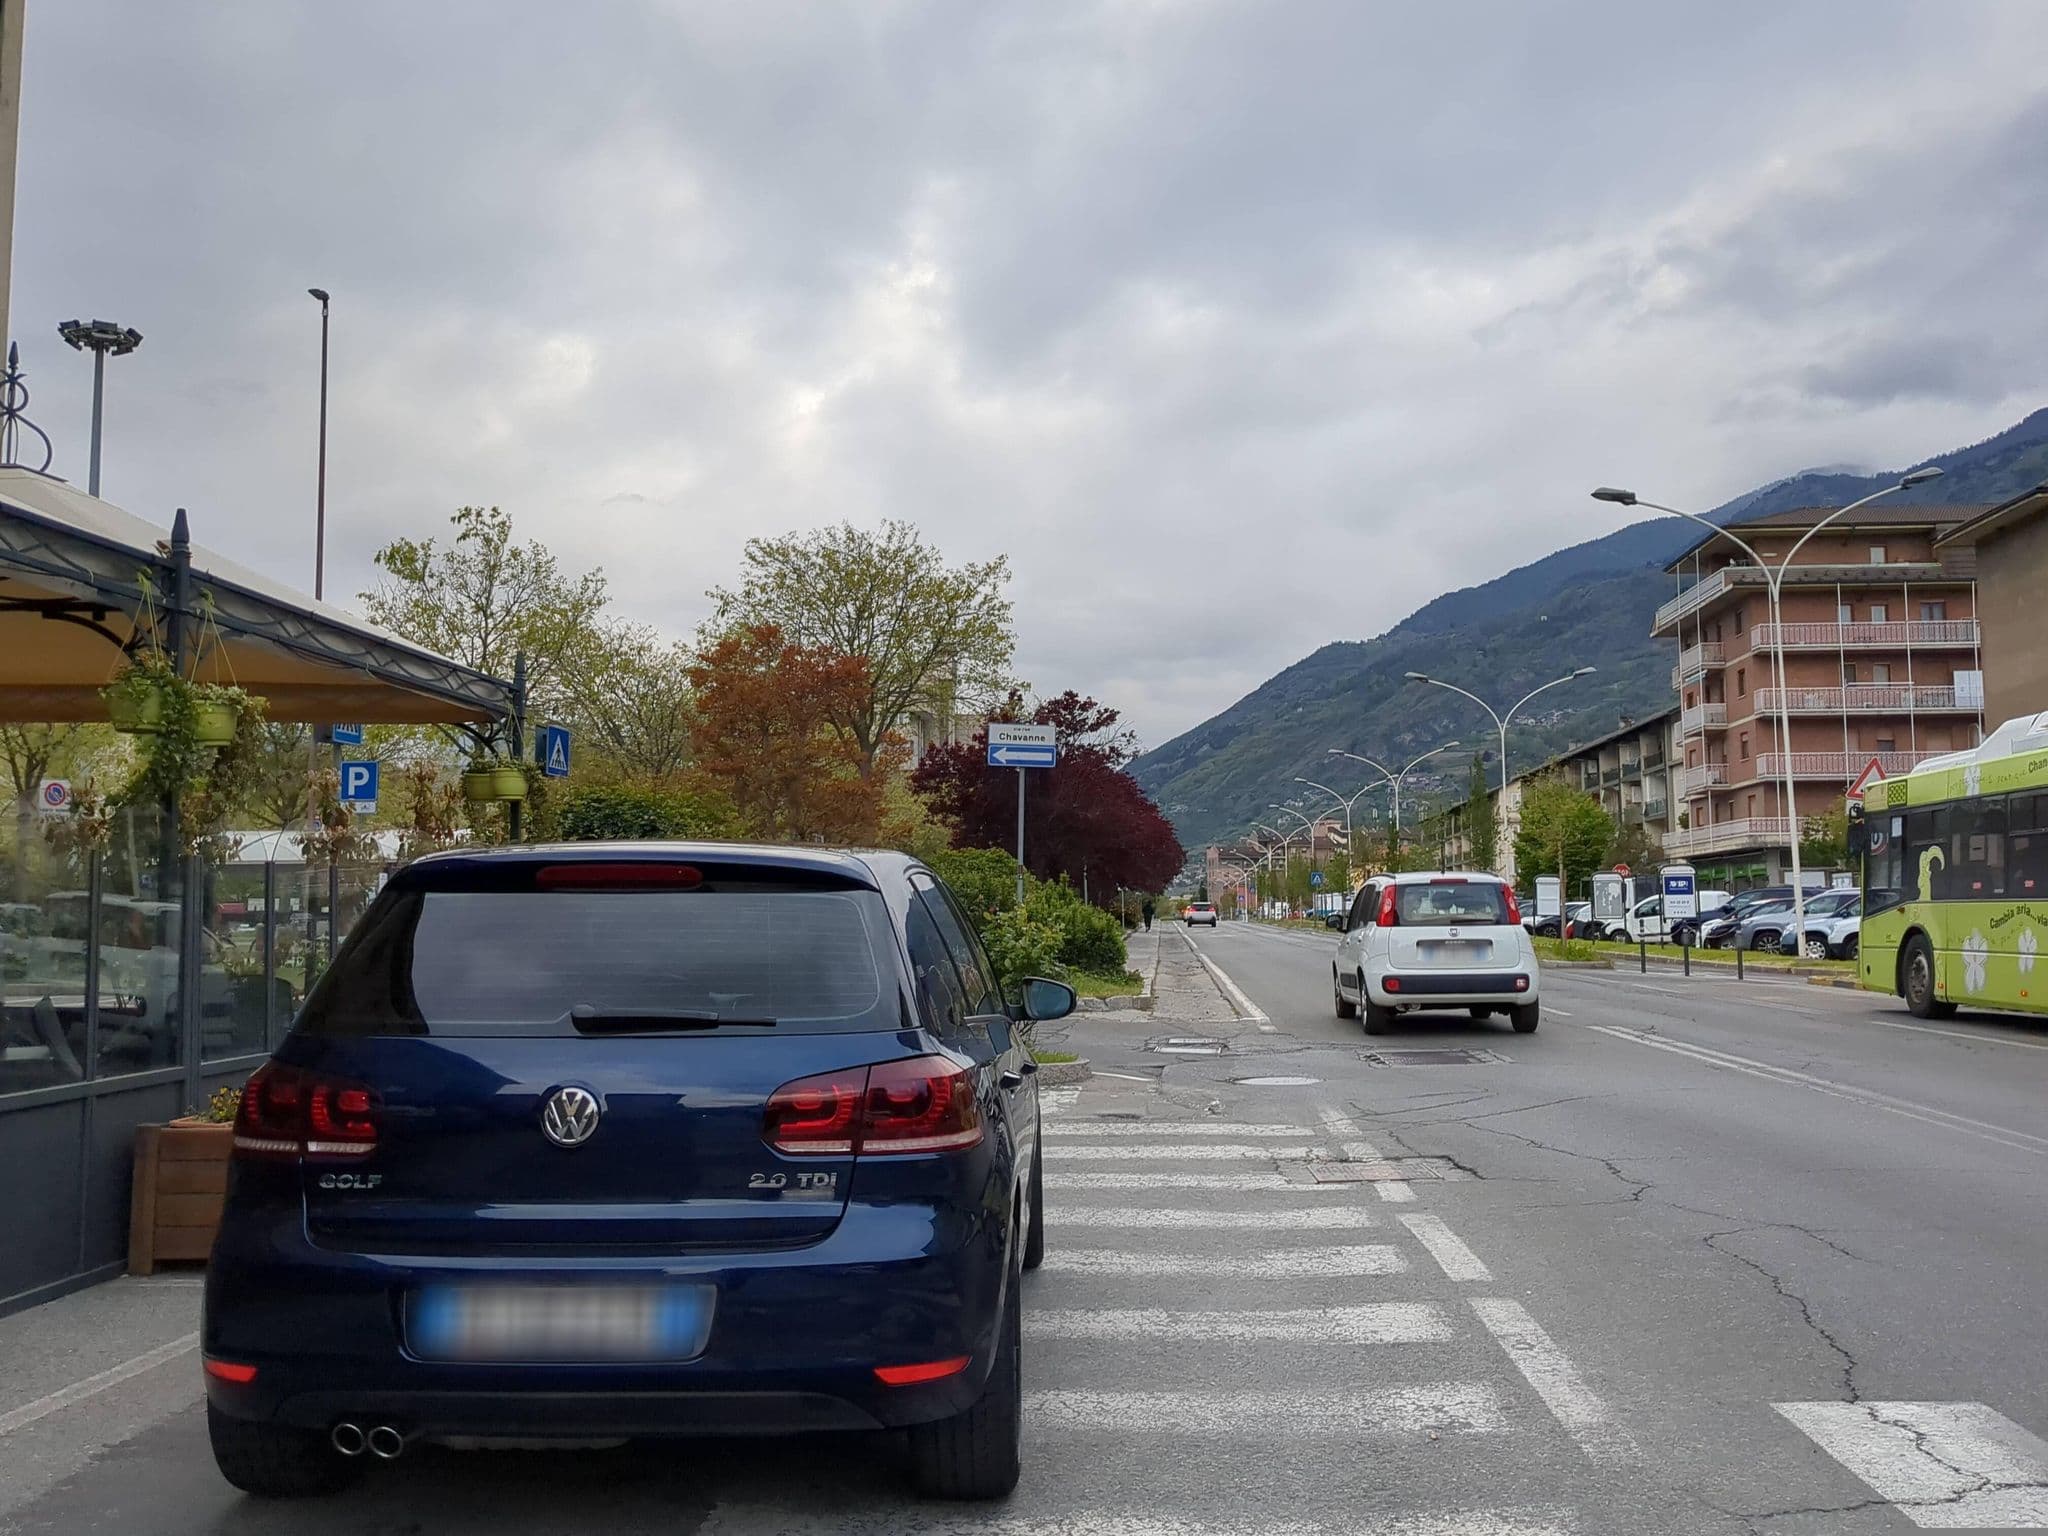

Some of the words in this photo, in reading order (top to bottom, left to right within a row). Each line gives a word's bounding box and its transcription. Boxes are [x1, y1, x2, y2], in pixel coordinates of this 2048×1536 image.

[999, 732, 1046, 742] Chavanne
[348, 766, 370, 796] P
[319, 1174, 382, 1188] GOLF
